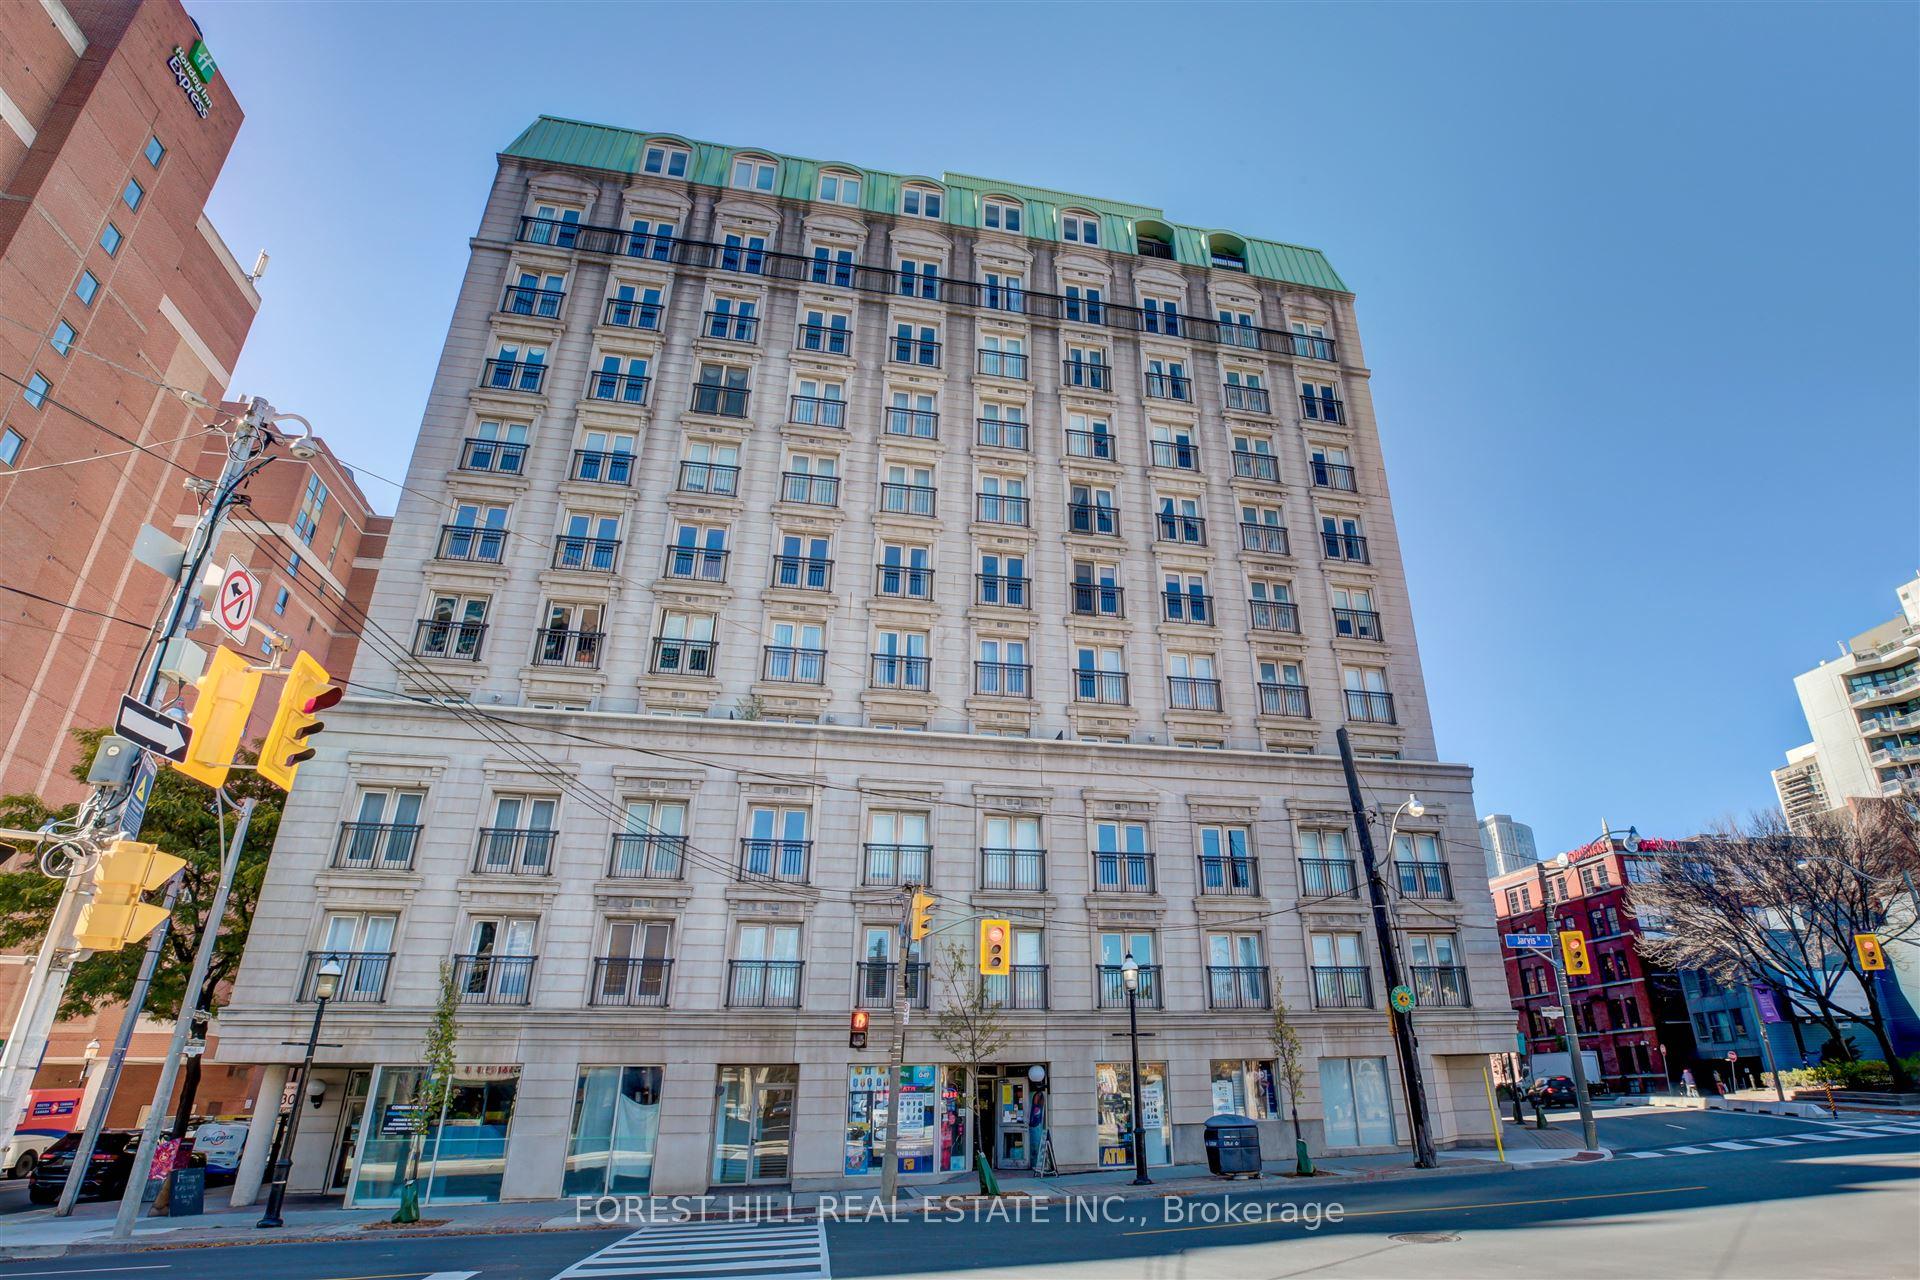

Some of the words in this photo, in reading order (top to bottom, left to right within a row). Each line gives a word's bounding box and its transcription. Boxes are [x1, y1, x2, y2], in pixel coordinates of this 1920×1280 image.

[170, 56, 209, 119] Express
[175, 46, 204, 92] Holiday
[201, 88, 213, 108] Inn
[1517, 936, 1536, 945] Jarvis
[1103, 1147, 1126, 1165] ATM
